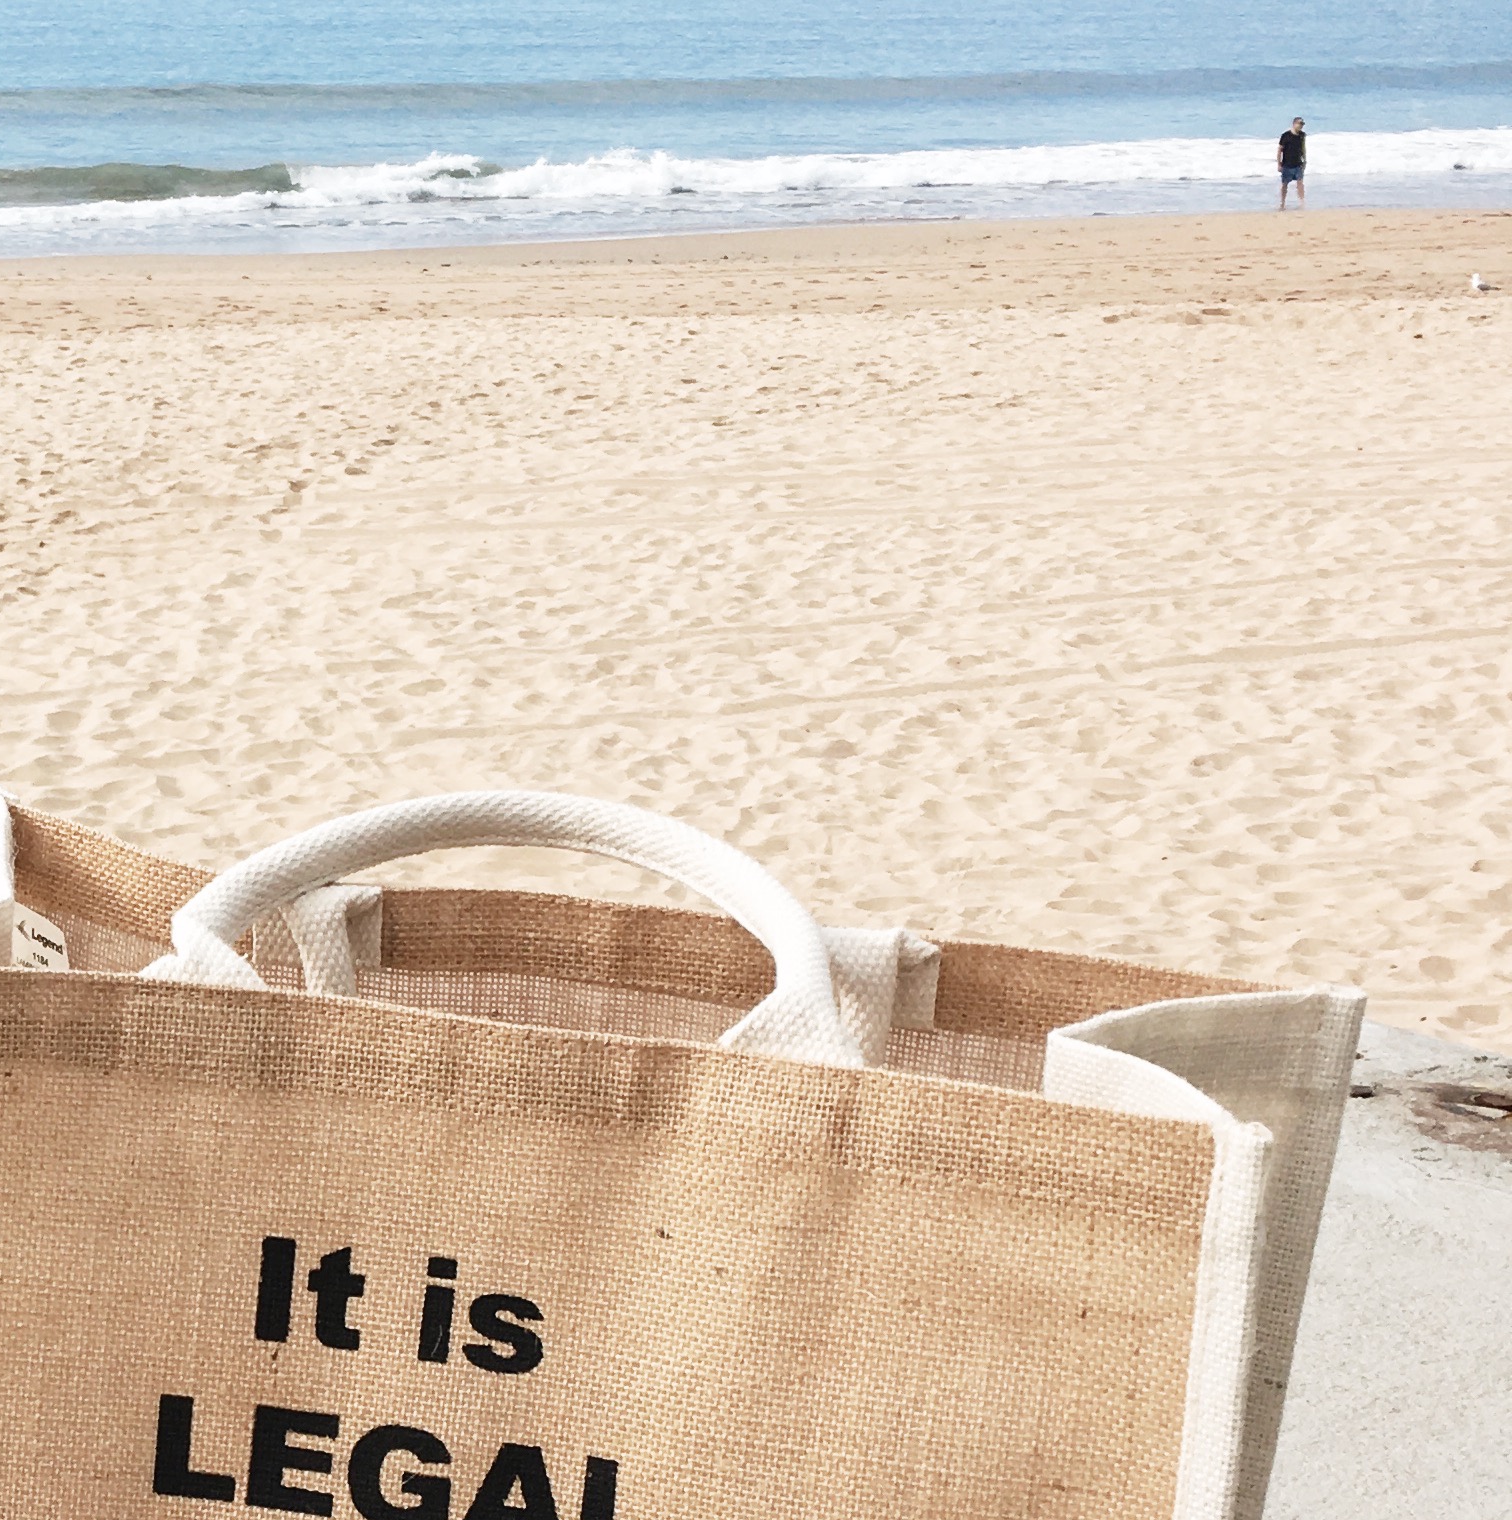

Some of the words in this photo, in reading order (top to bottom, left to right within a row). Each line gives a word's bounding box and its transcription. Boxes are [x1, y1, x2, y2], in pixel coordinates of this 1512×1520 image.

[31, 927, 64, 956] Legend
[254, 1235, 366, 1351] It
[418, 1256, 545, 1375] is
